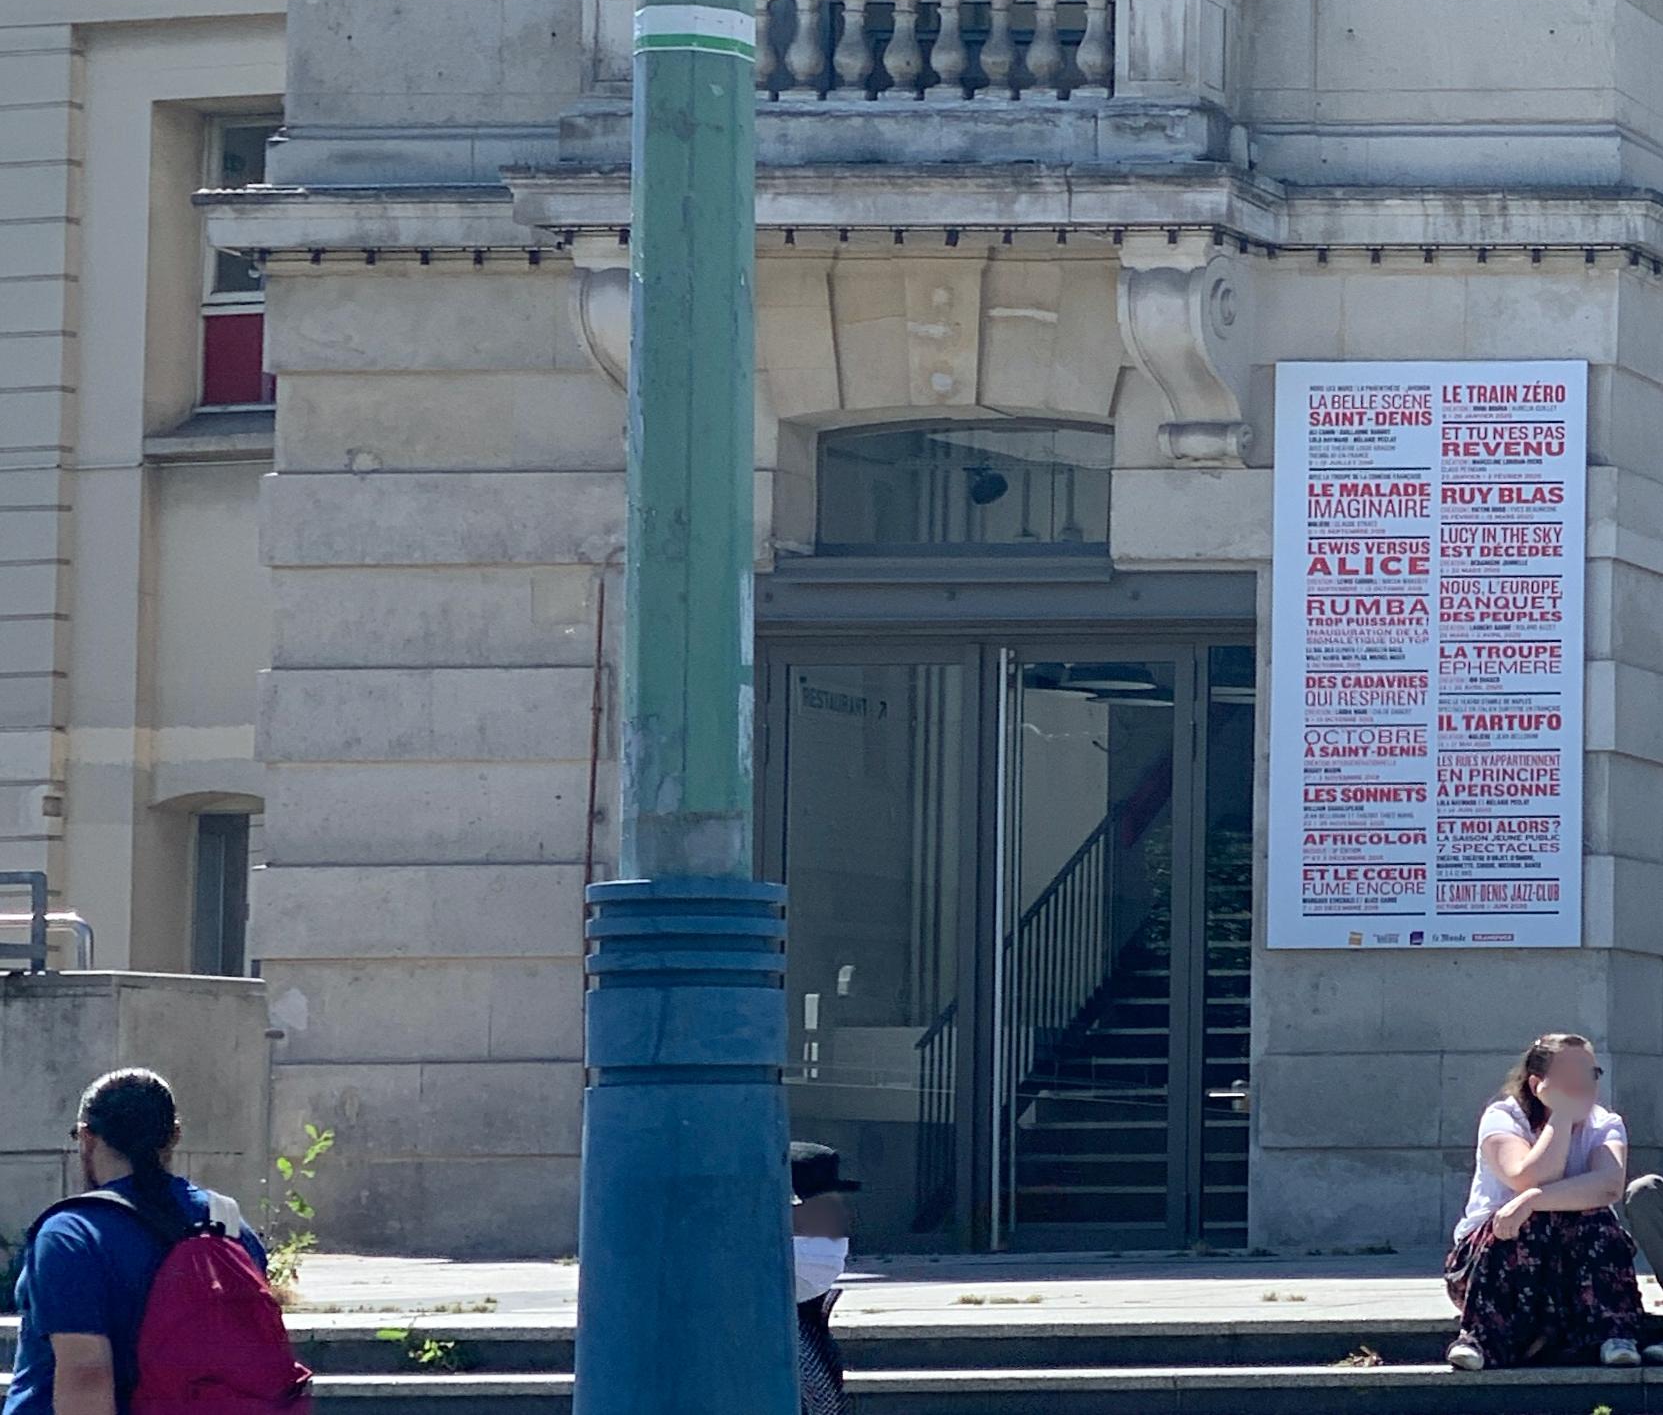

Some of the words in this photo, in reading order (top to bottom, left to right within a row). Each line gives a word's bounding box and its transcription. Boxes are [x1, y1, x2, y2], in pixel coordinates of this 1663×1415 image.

[1442, 385, 1462, 403] LE
[1466, 385, 1517, 403] TRAIN
[1522, 380, 1566, 403] ZÉRO
[1309, 394, 1327, 409] LA
[1331, 394, 1377, 409] BELLE
[1309, 411, 1432, 426] SAINT-DENIS
[1442, 426, 1462, 440] ET
[1466, 426, 1487, 440] TU
[1493, 426, 1528, 440] N'ES
[1533, 426, 1565, 440] PAS
[1442, 442, 1565, 456] REVENU
[1308, 483, 1334, 497] LE
[1340, 483, 1431, 497] MALADE
[1441, 487, 1493, 504] RUY
[1498, 487, 1564, 504] BLAS
[1308, 498, 1431, 518] IMAGINAIRE
[1440, 527, 1479, 543] LUCY
[1482, 527, 1497, 543] IN
[1501, 527, 1529, 543] THE
[1533, 527, 1563, 543] SKY
[1308, 541, 1360, 555] LEWIS
[1364, 541, 1430, 555] VERSUS
[1440, 545, 1475, 557] EST
[1480, 542, 1563, 557] DÉCÉDÉE
[1307, 556, 1430, 576] ALICE
[1440, 580, 1485, 595] NOUS,
[1489, 580, 1563, 595] L'EUROPE,
[1307, 598, 1430, 616] RUMBA
[1440, 596, 1563, 610] BANQUET
[1307, 617, 1342, 626] TROP
[1347, 617, 1424, 626] PUISSANTE
[1440, 611, 1475, 622] DES
[1480, 611, 1563, 622] PEUPLES
[1439, 645, 1468, 659] LA
[1473, 645, 1562, 659] TROUPE
[1306, 675, 1337, 689] DES
[1341, 675, 1428, 689] CADAVRES
[1306, 690, 1332, 706] QUI
[1337, 690, 1428, 706] RESPIRENT
[1438, 714, 1458, 731] IL
[1462, 714, 1562, 731] TARTUFO
[1304, 729, 1427, 745] OCTOBRE
[1319, 745, 1428, 757] SAINT-DENIS
[1437, 754, 1453, 767] LES
[1456, 754, 1478, 767] RUES
[1481, 754, 1560, 767] N'APPARTIENNENT
[1438, 768, 1462, 782] EN
[1469, 768, 1560, 782] PRINCIPE
[1304, 787, 1337, 803] LES
[1340, 787, 1427, 803] SONNETS
[1455, 783, 1560, 797] PERSONNE
[1437, 821, 1457, 834] ET
[1461, 821, 1492, 834] MOI
[1496, 821, 1550, 834] ALORS
[1304, 833, 1427, 846] AFRICOLOR
[1437, 843, 1446, 853] 7
[1451, 843, 1560, 853] SPECTACLES
[1303, 868, 1329, 881] ET
[1334, 868, 1358, 881] LE
[1363, 868, 1427, 881] CŒUR
[1303, 882, 1351, 895] FUME
[1356, 882, 1426, 895] ENCORE
[1436, 883, 1446, 903] LE
[1449, 883, 1508, 903] SAINT-DENIS
[1510, 883, 1559, 903] JAZZ-CLUB
